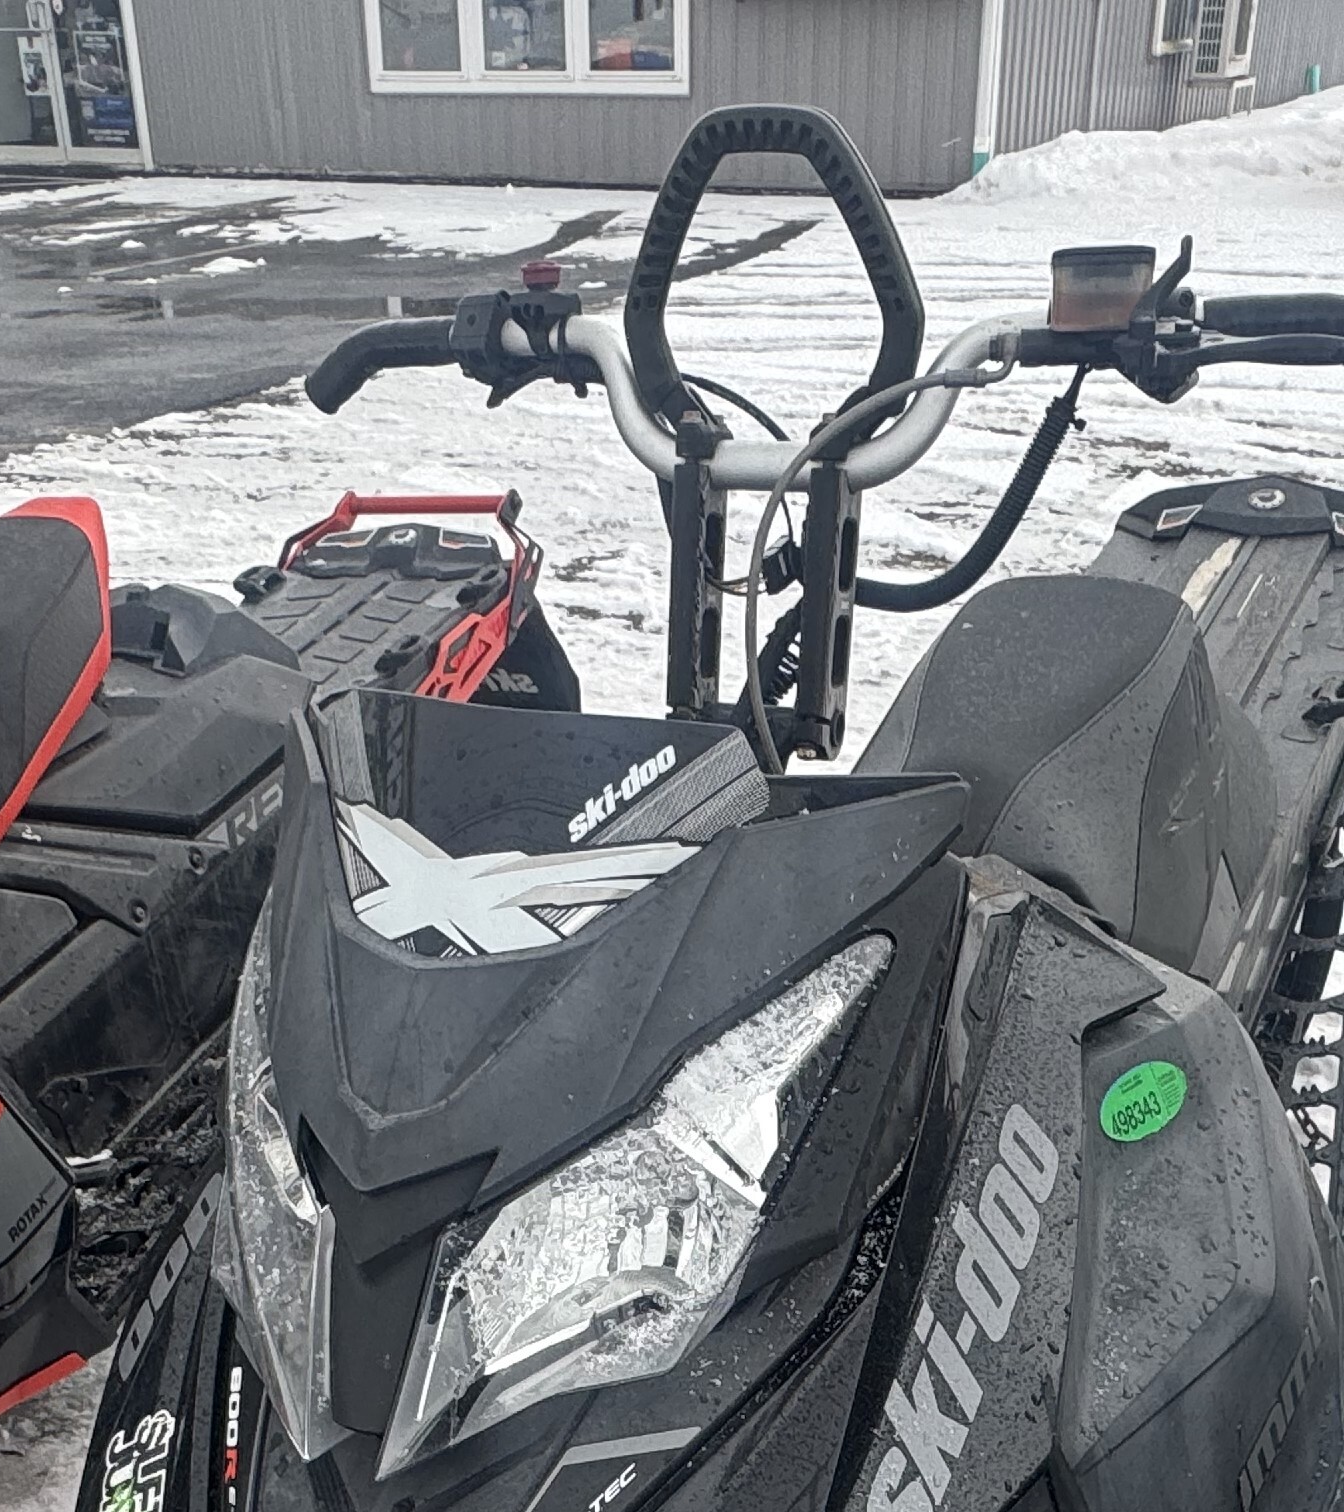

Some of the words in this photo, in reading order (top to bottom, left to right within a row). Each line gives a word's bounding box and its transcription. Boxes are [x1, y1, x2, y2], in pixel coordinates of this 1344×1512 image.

[567, 744, 676, 843] ski-doo
[1112, 1090, 1162, 1137] 498343
[7, 1193, 48, 1244] ROTAX
[225, 1366, 243, 1484] 800R
